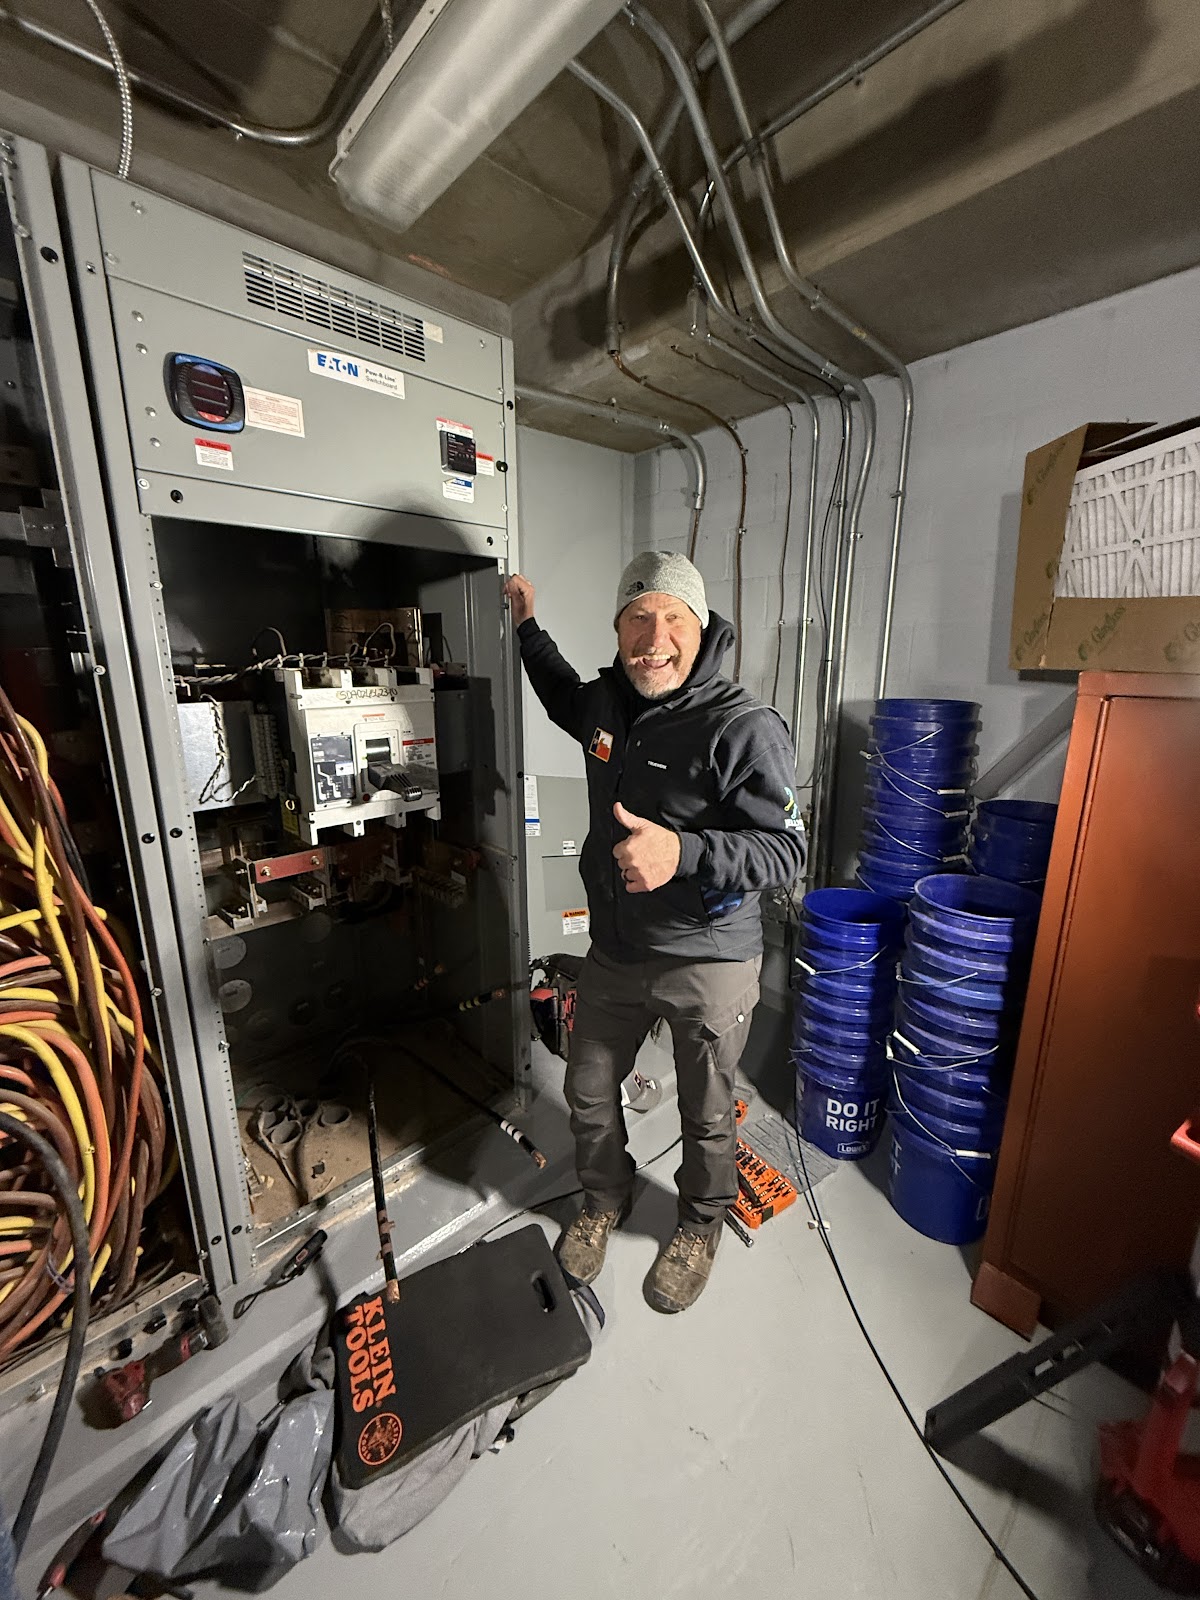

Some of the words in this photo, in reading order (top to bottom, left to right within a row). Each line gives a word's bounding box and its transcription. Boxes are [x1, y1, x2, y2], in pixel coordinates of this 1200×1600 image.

[317, 353, 359, 378] EATON
[365, 376, 398, 391] Switchboard
[826, 1097, 859, 1118] DO
[864, 1098, 880, 1117] IT
[825, 1114, 878, 1133] RIGHT
[345, 1304, 374, 1413] TOOLS
[363, 1296, 397, 1401] KLEIN
